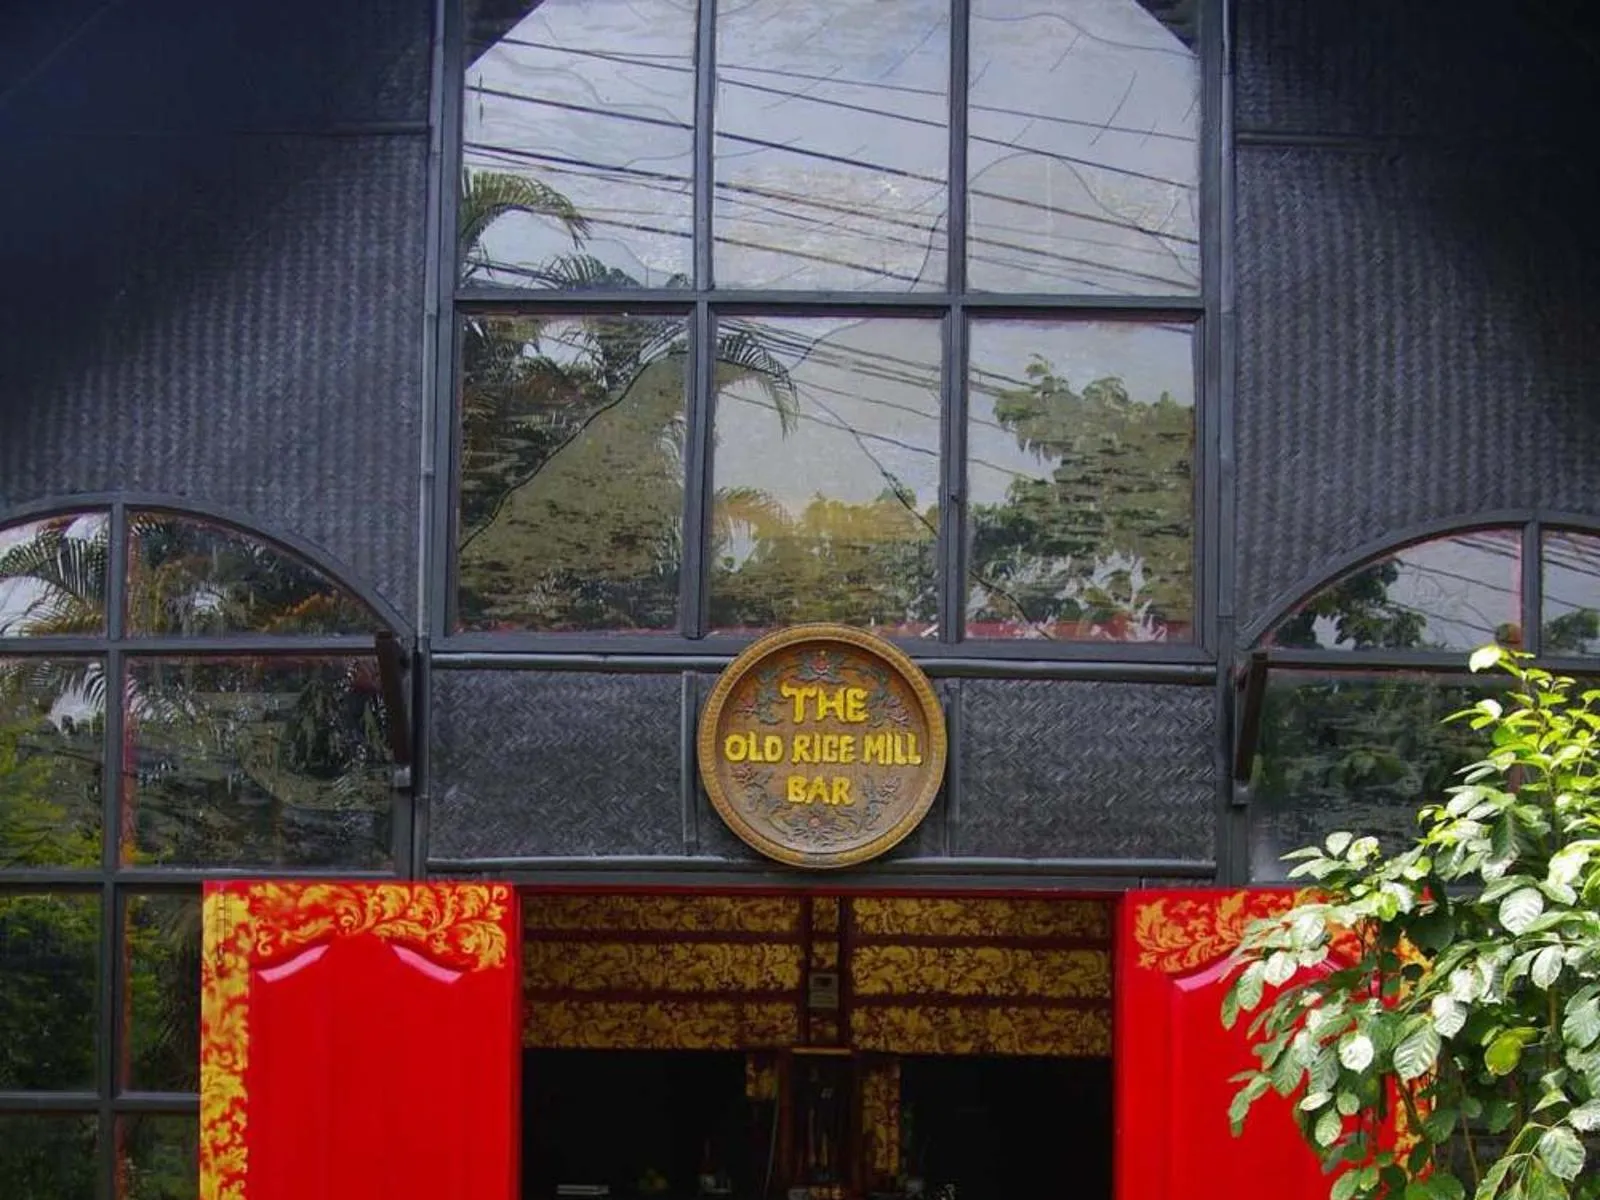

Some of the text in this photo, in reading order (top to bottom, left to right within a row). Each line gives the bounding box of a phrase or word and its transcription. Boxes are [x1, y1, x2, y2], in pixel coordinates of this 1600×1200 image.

[781, 682, 869, 723] THE
[724, 731, 923, 766] OLD RICE MILL
[786, 775, 854, 806] BAR
